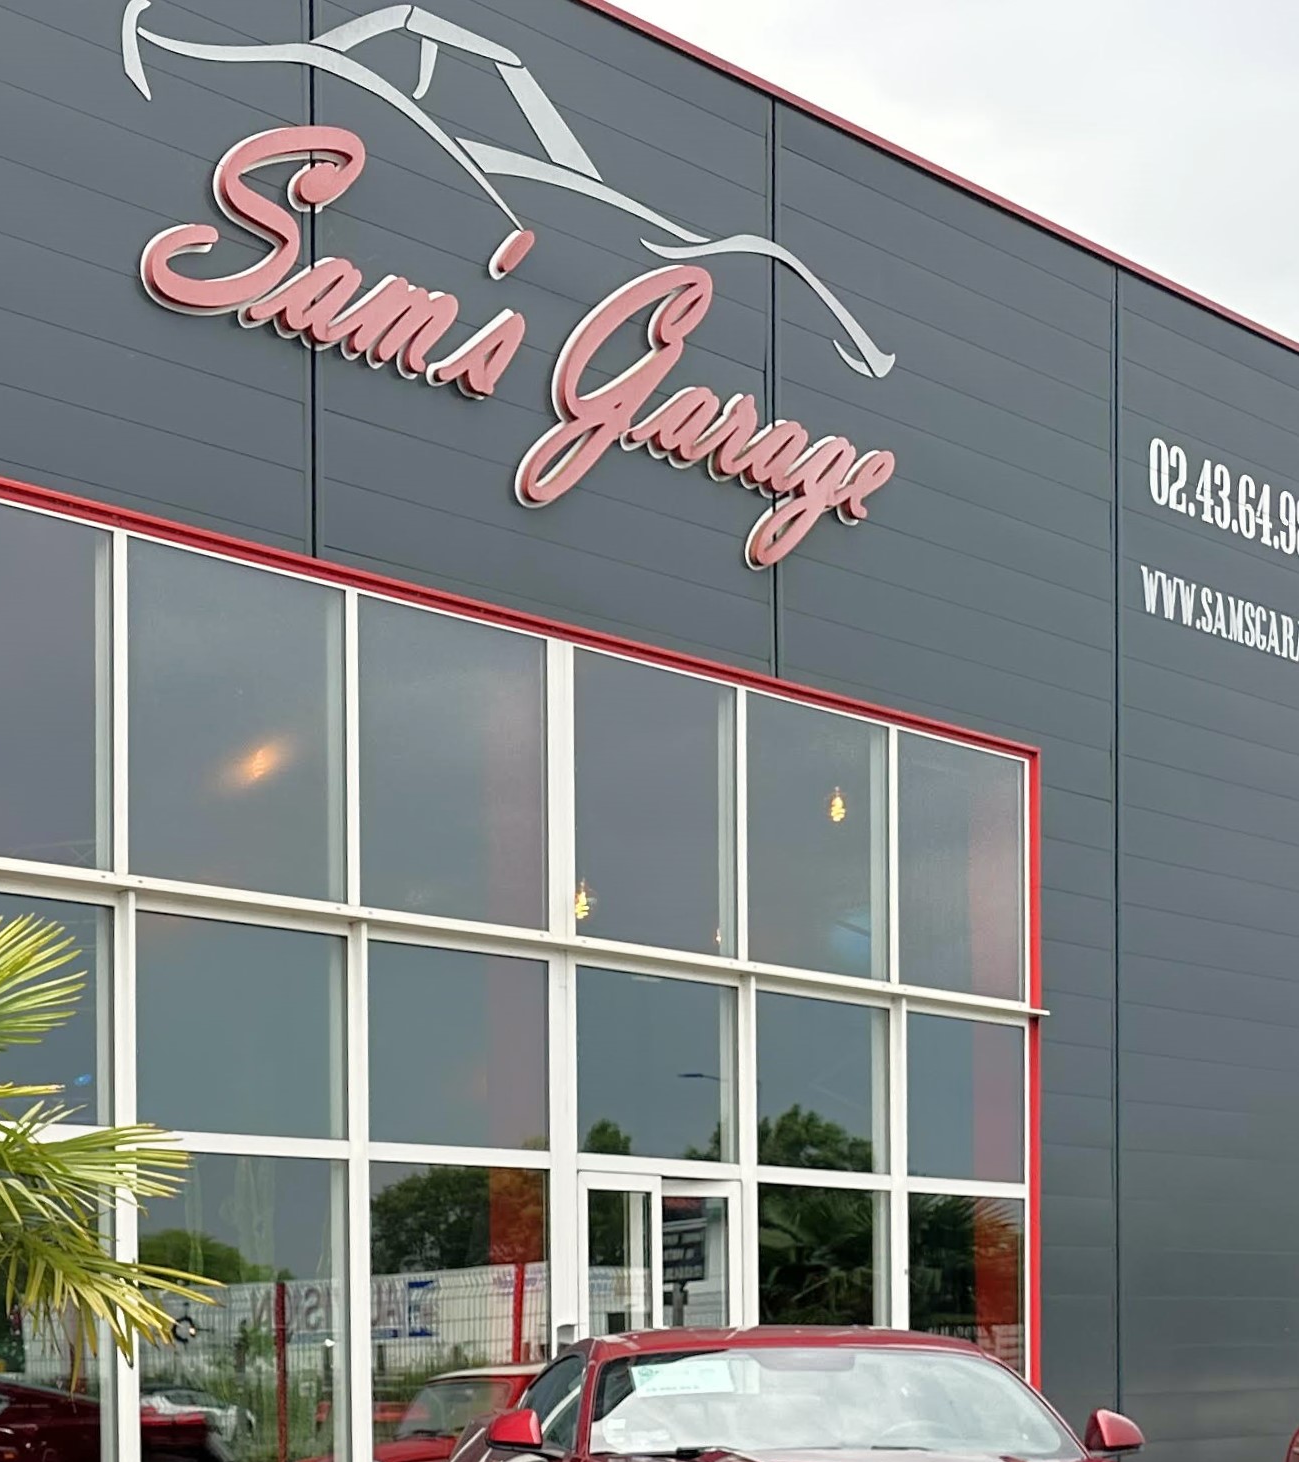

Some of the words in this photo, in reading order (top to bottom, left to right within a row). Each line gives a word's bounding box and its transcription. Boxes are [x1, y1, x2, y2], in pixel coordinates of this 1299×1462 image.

[140, 125, 535, 399] Sam's
[514, 265, 895, 571] Garage
[1150, 437, 1299, 557] 02.43.64.9
[1141, 565, 1299, 663] WWW.SAMSGAR
